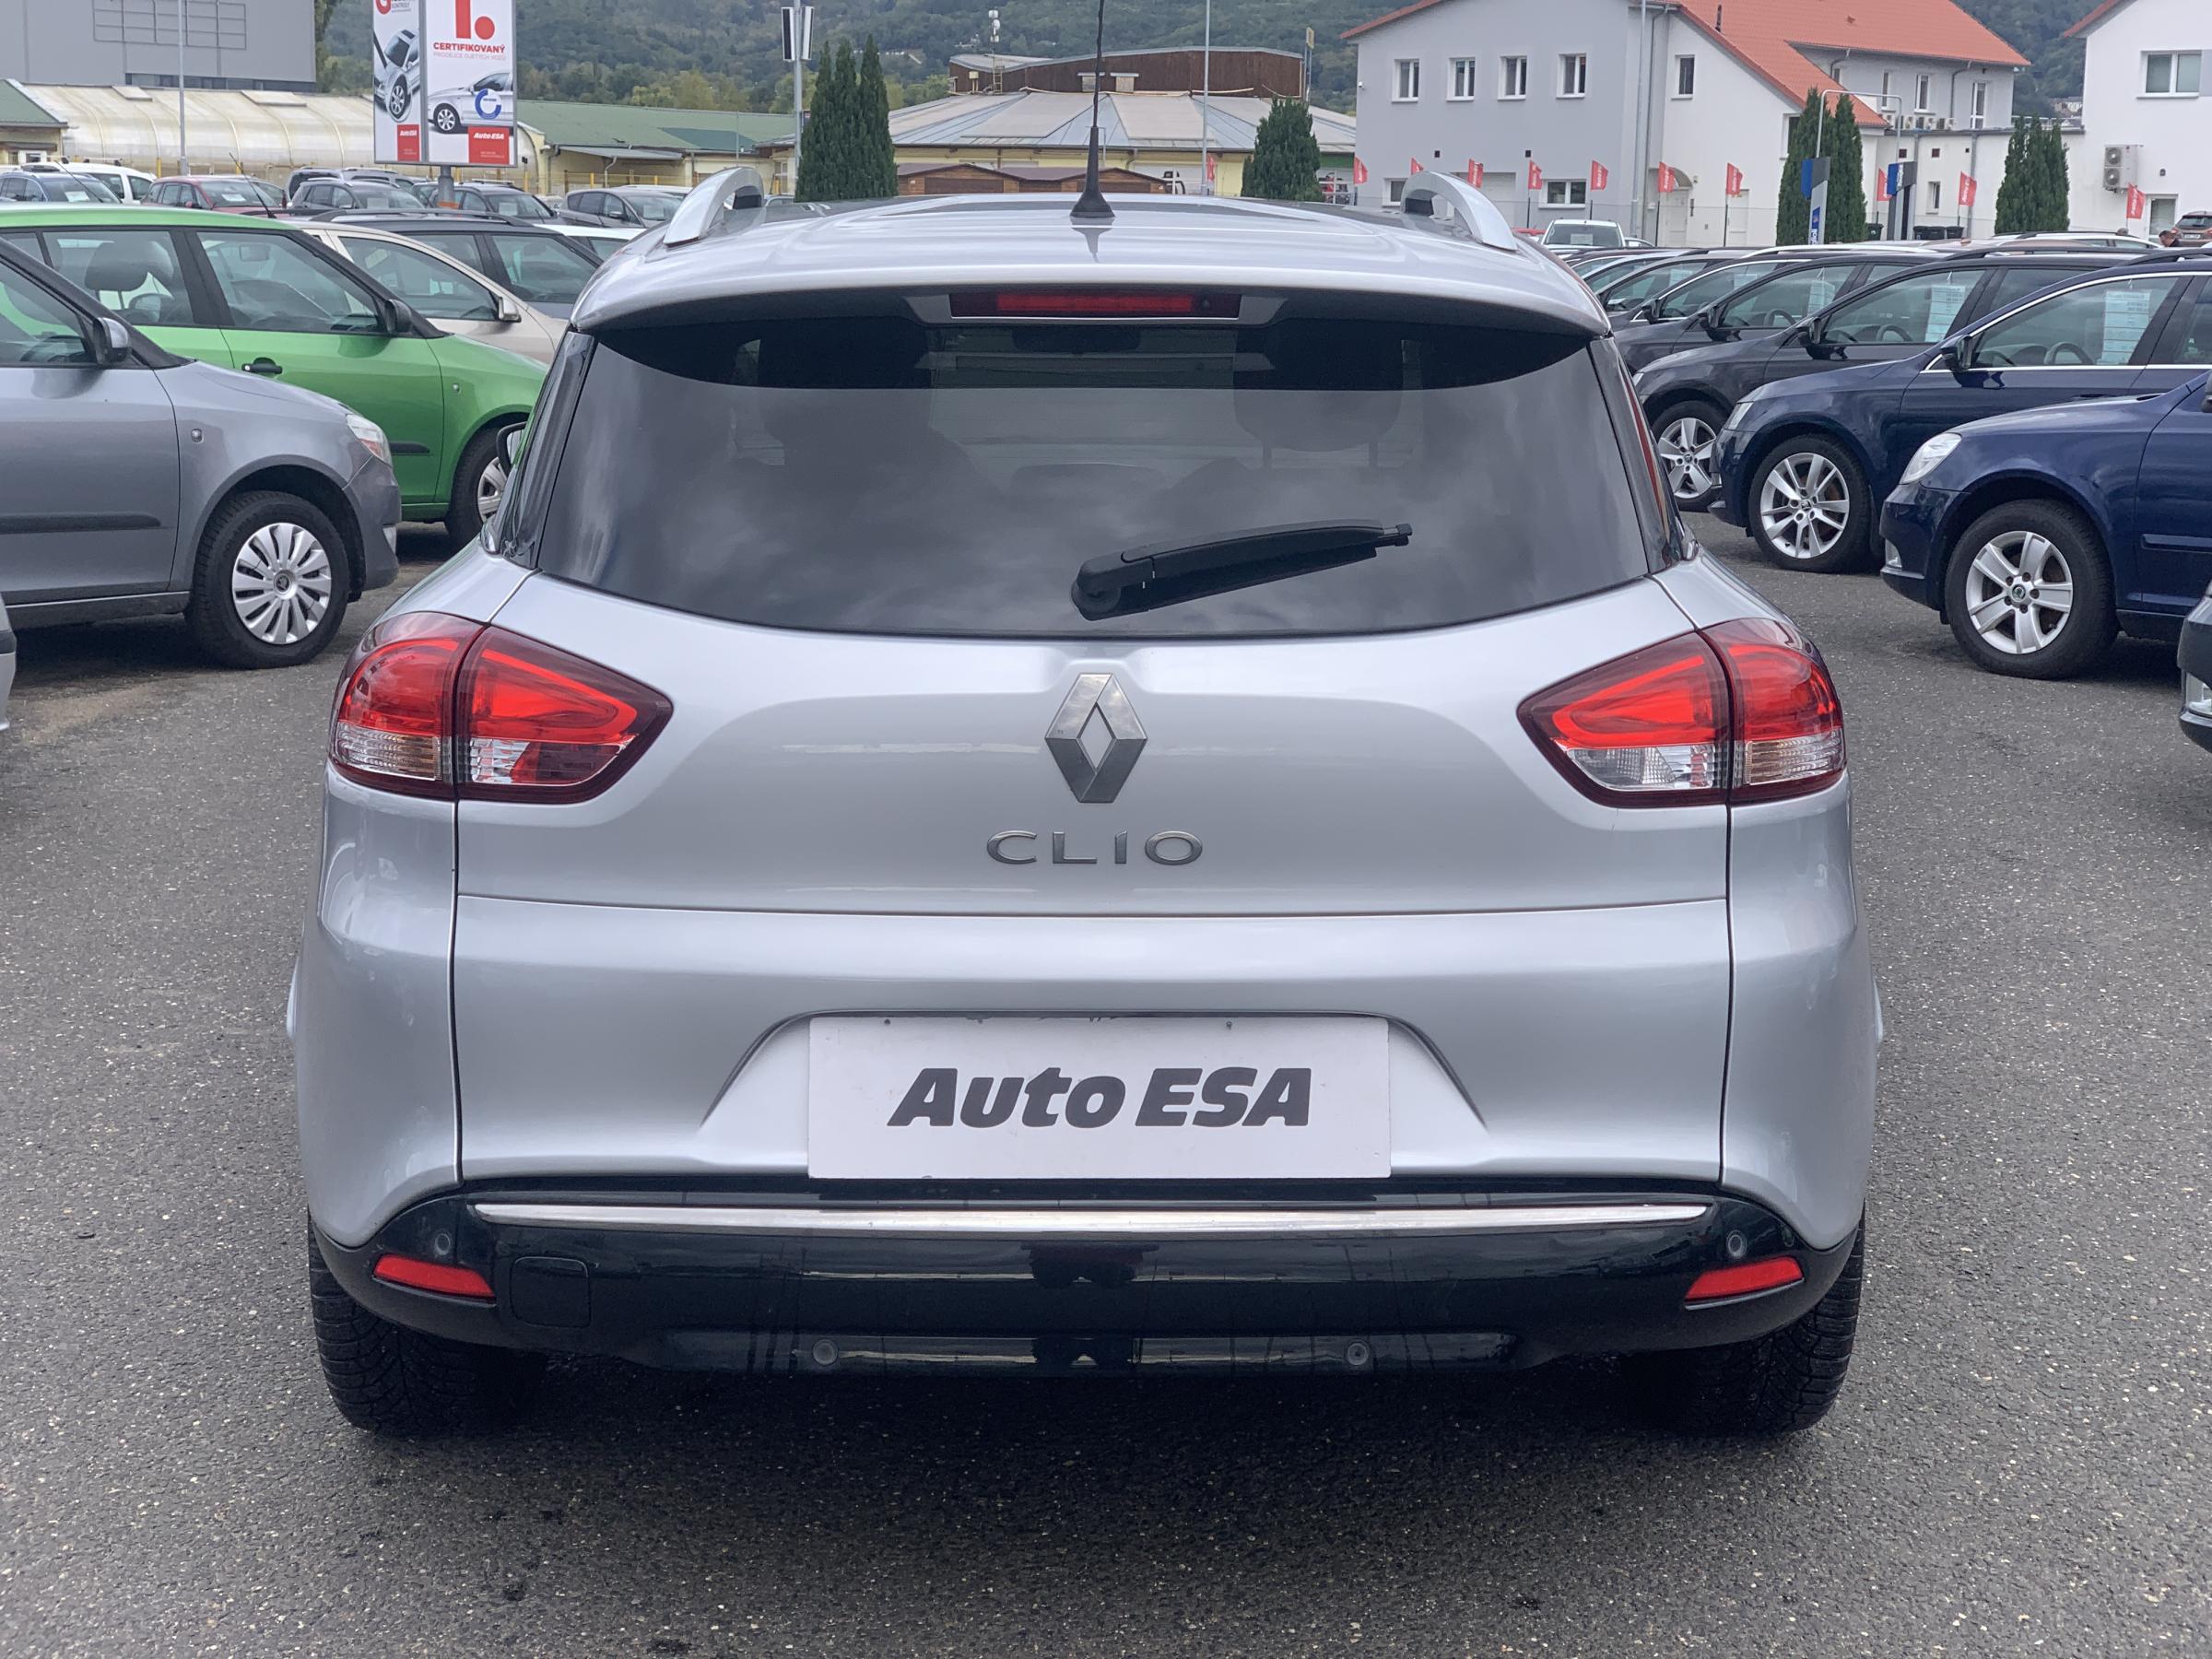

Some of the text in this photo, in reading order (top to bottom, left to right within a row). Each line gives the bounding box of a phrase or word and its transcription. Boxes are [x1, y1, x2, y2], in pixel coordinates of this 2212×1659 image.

[433, 42, 506, 53] CERTIFIKOVANÝ
[987, 830, 1203, 865] CLIO
[887, 1066, 1312, 1128] Auto ESA
